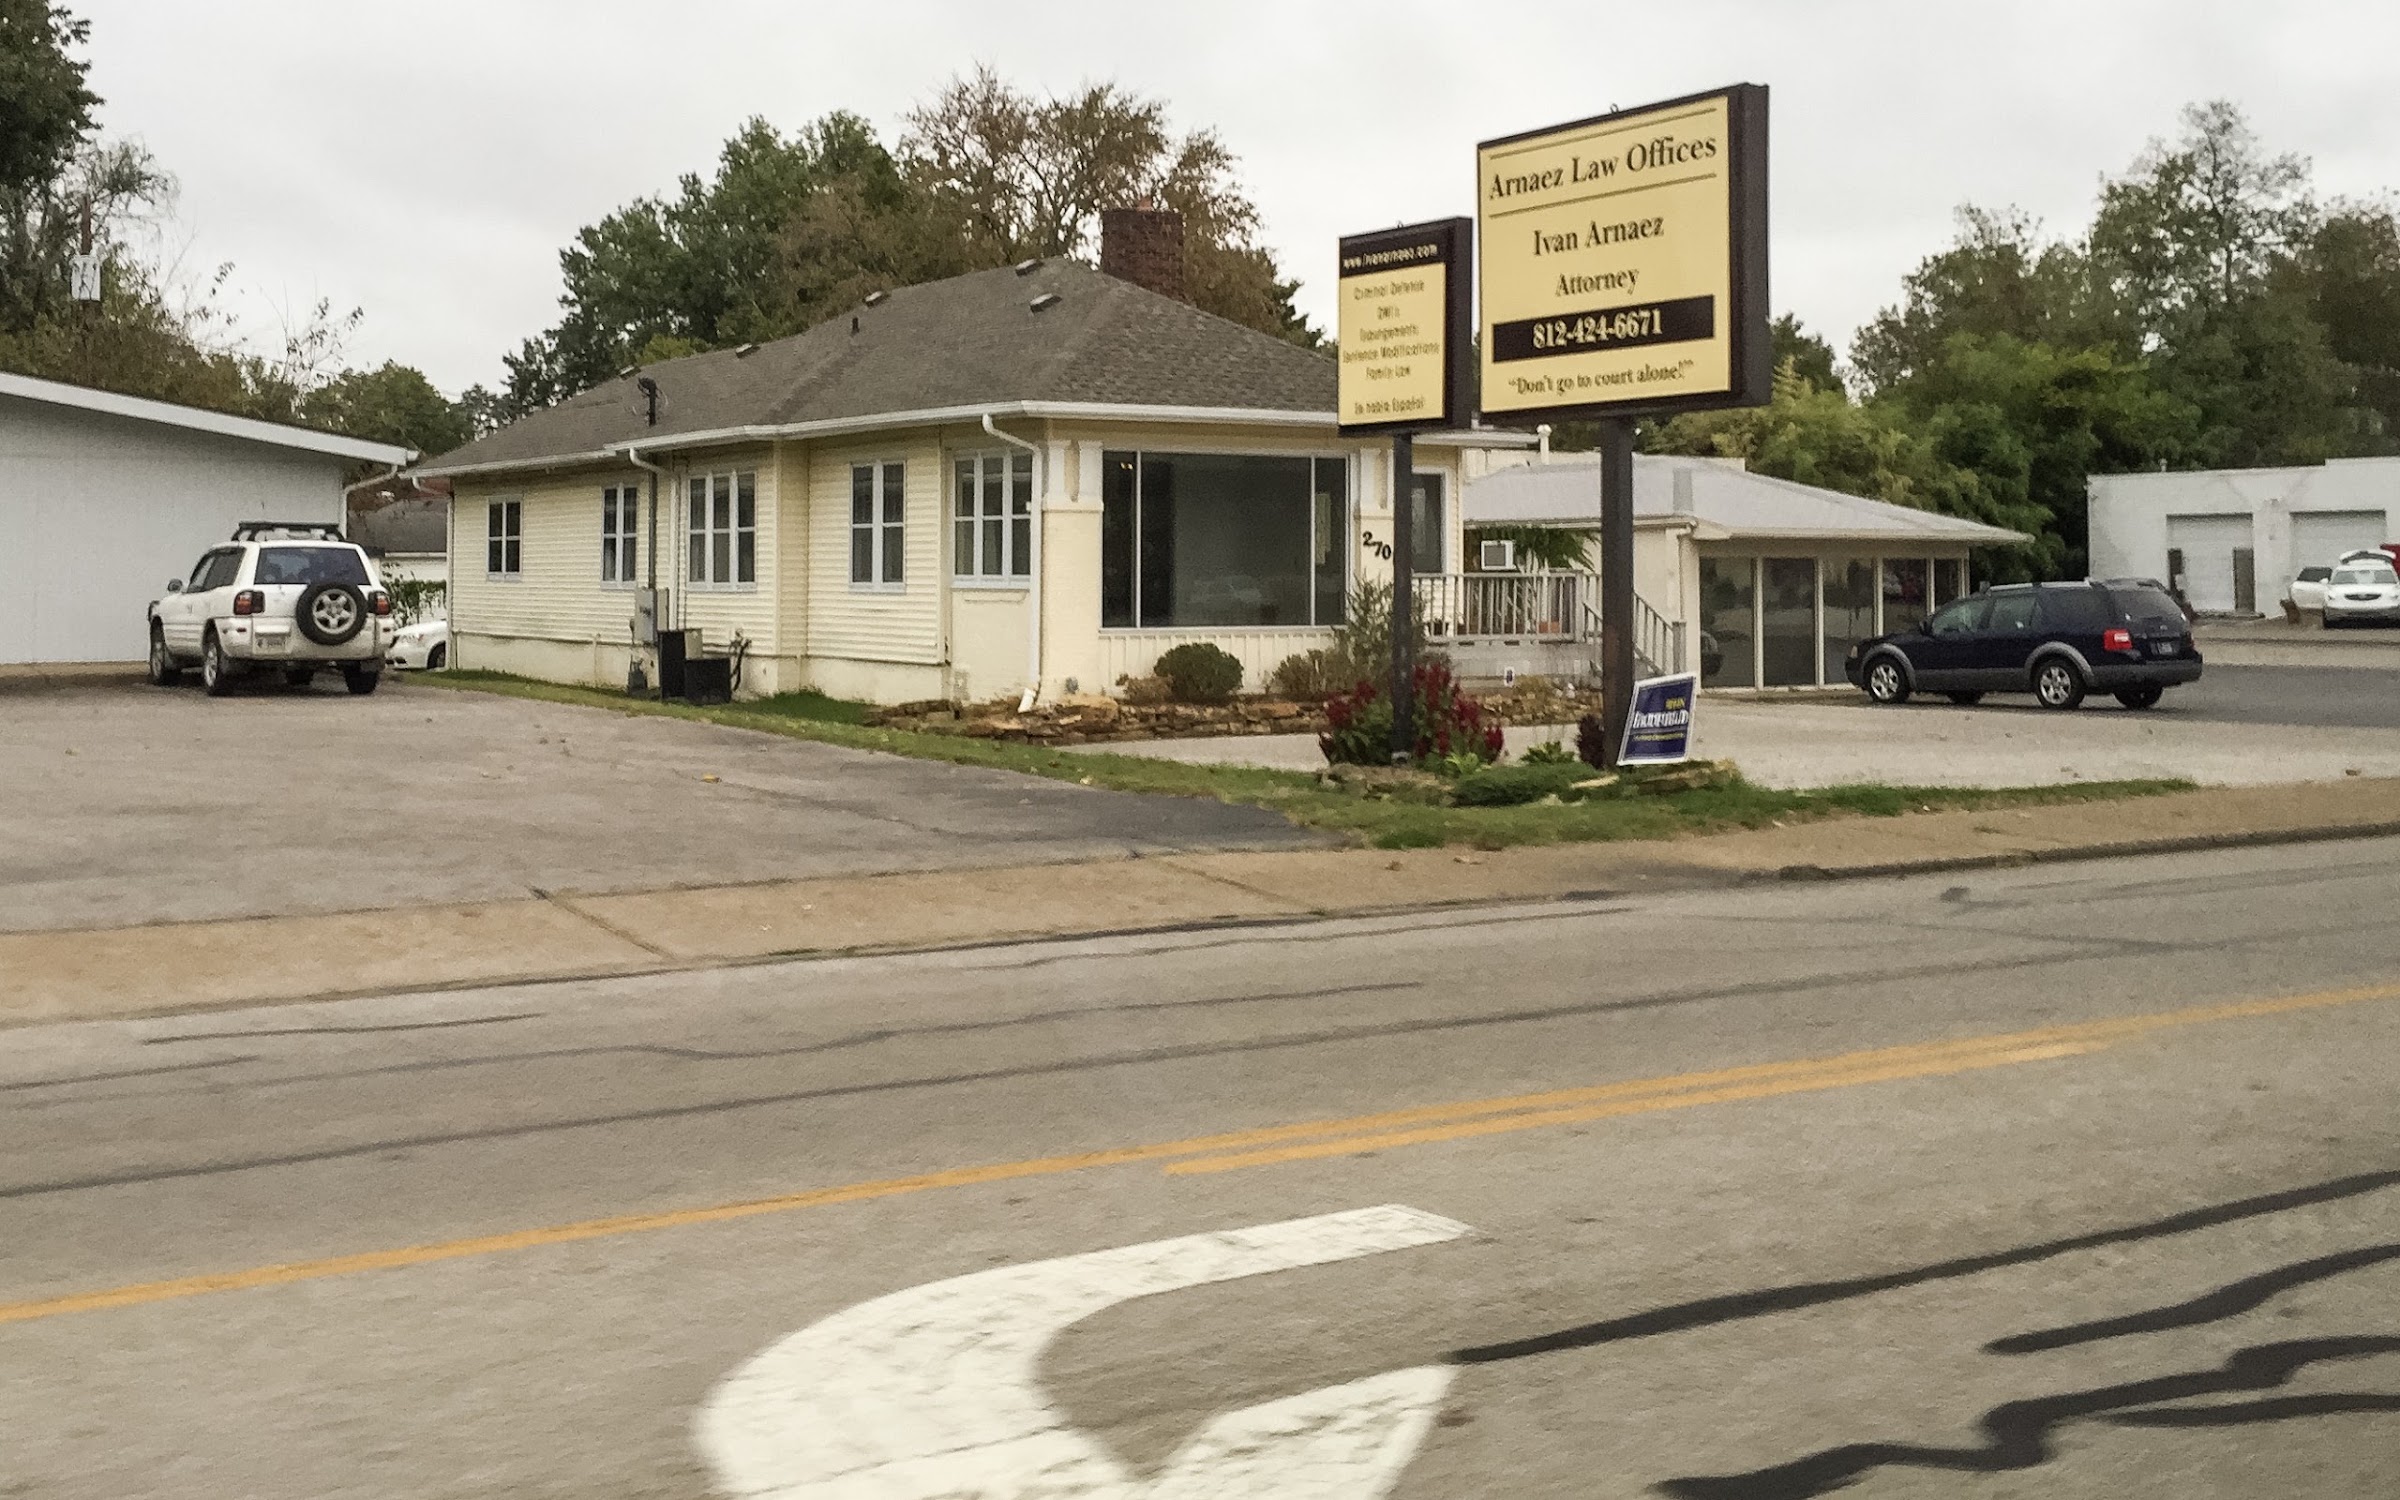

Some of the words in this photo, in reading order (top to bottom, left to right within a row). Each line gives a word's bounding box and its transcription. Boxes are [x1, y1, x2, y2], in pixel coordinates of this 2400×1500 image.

[1489, 167, 1563, 199] Arnaez
[1571, 155, 1619, 184] Law
[1626, 135, 1717, 172] Offices
[1533, 228, 1578, 256] Ivan
[1585, 216, 1664, 248] Arnaez
[1555, 268, 1639, 297] Attorney
[1532, 308, 1662, 349] 812-424-6671
[1556, 376, 1574, 396] go
[1577, 371, 1592, 388] to
[1594, 366, 1633, 386] court
